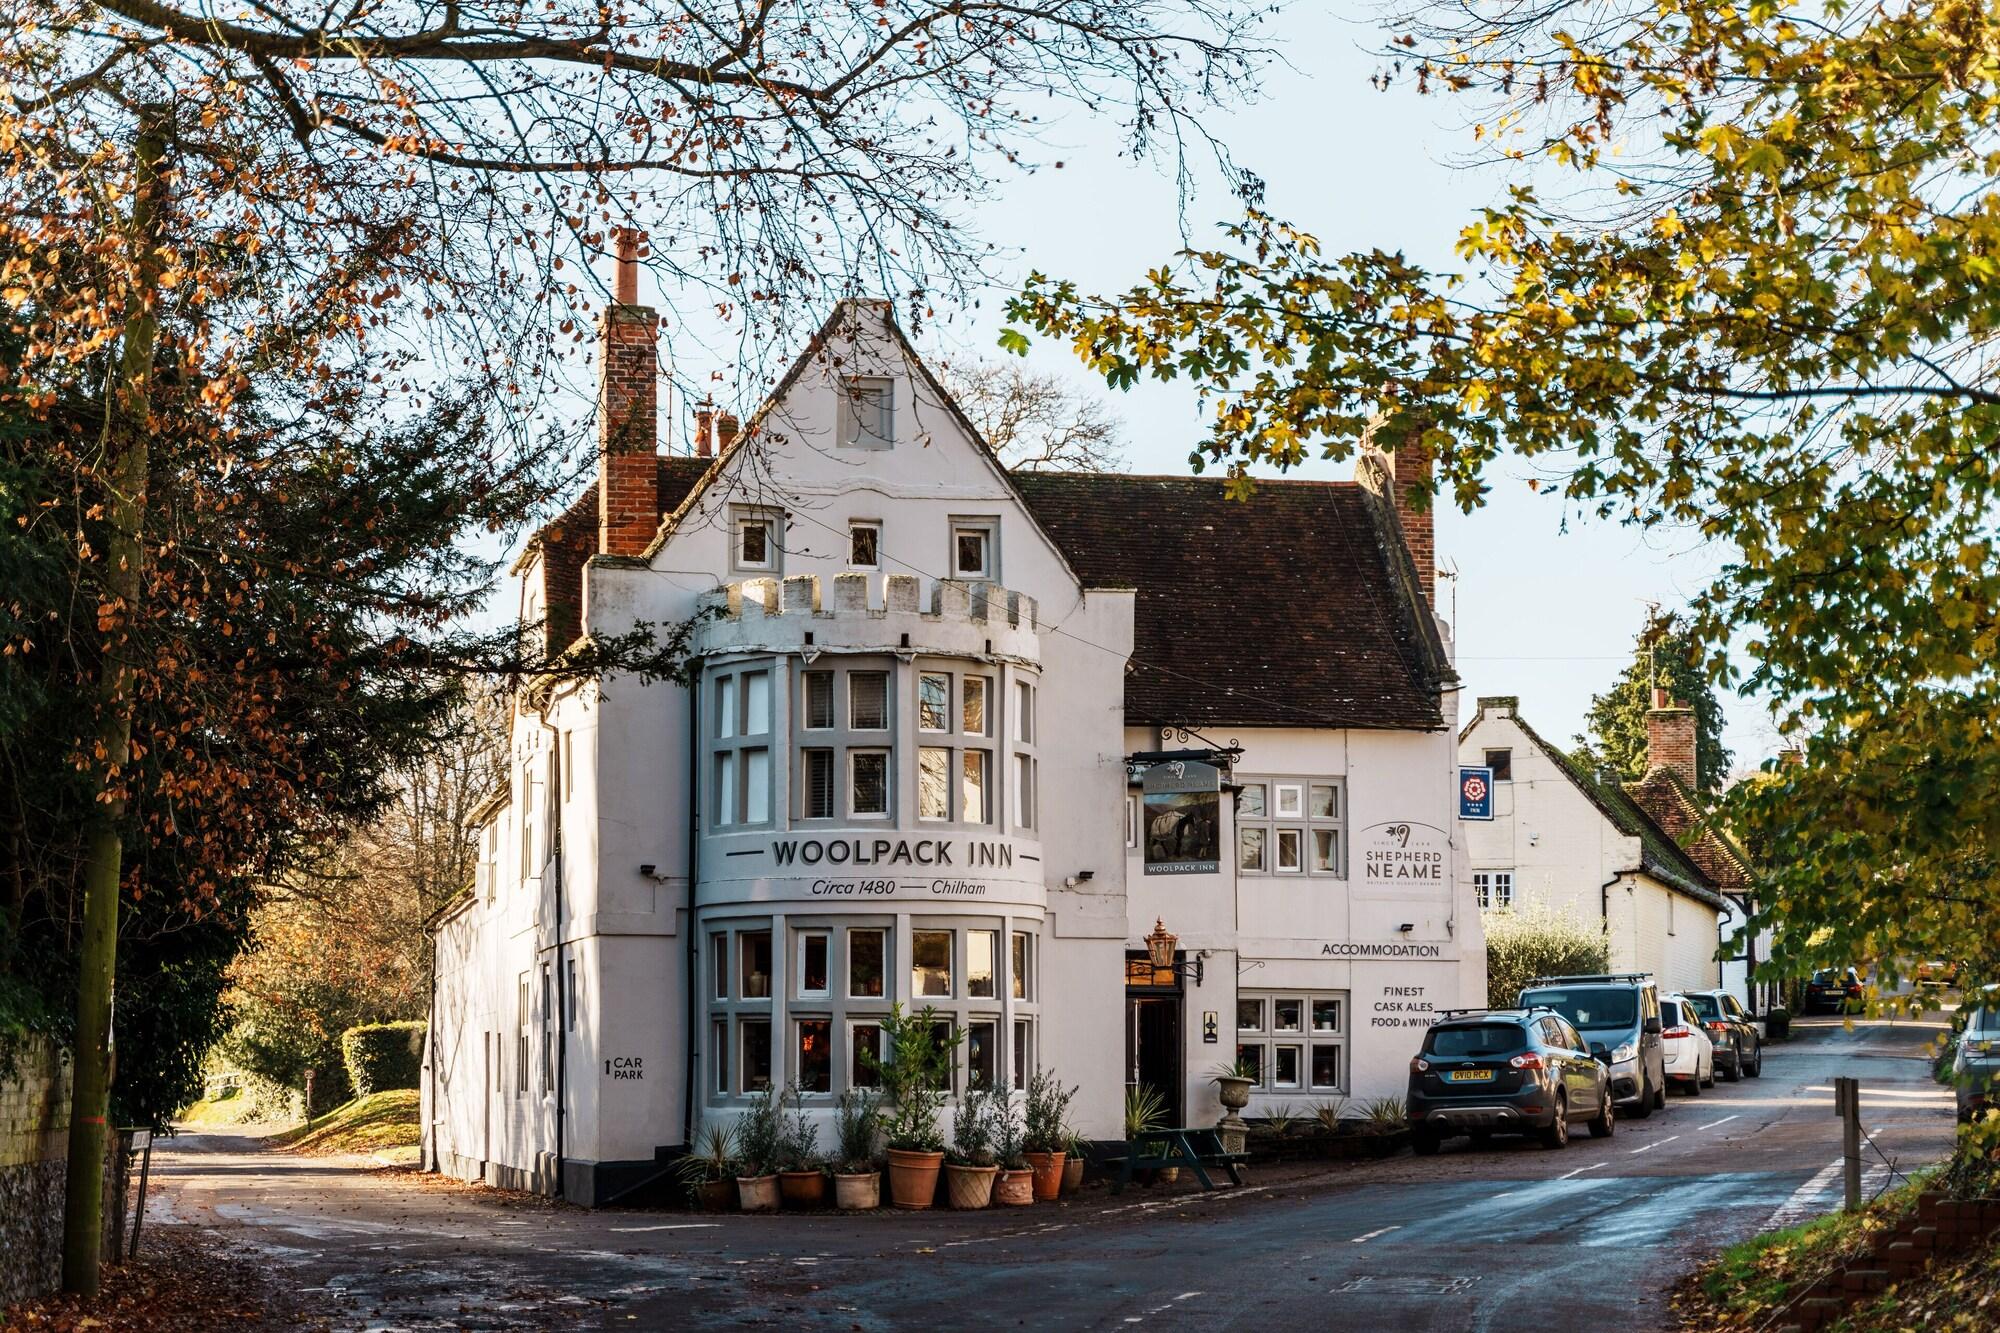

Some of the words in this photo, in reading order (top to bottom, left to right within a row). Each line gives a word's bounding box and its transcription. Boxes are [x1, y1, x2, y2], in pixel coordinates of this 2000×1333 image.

[772, 839, 953, 867] WOOLPACK
[968, 841, 1013, 867] INN
[1366, 850, 1442, 862] SHEPHERD
[1148, 864, 1196, 873] WOOLPACK
[1367, 863, 1441, 879] NEAME
[811, 879, 853, 895] Circa
[858, 880, 896, 895] 1480
[931, 879, 986, 895] Chilham
[1321, 943, 1440, 957] ACCOMMODATION
[1383, 986, 1425, 996] FINEST
[1374, 1002, 1403, 1012] CASK
[1406, 1002, 1434, 1012] ALES
[1371, 1018, 1400, 1027] FOOD
[613, 1057, 643, 1069] CAR
[614, 1070, 643, 1080] PARK
[1473, 1070, 1489, 1079] RCX
